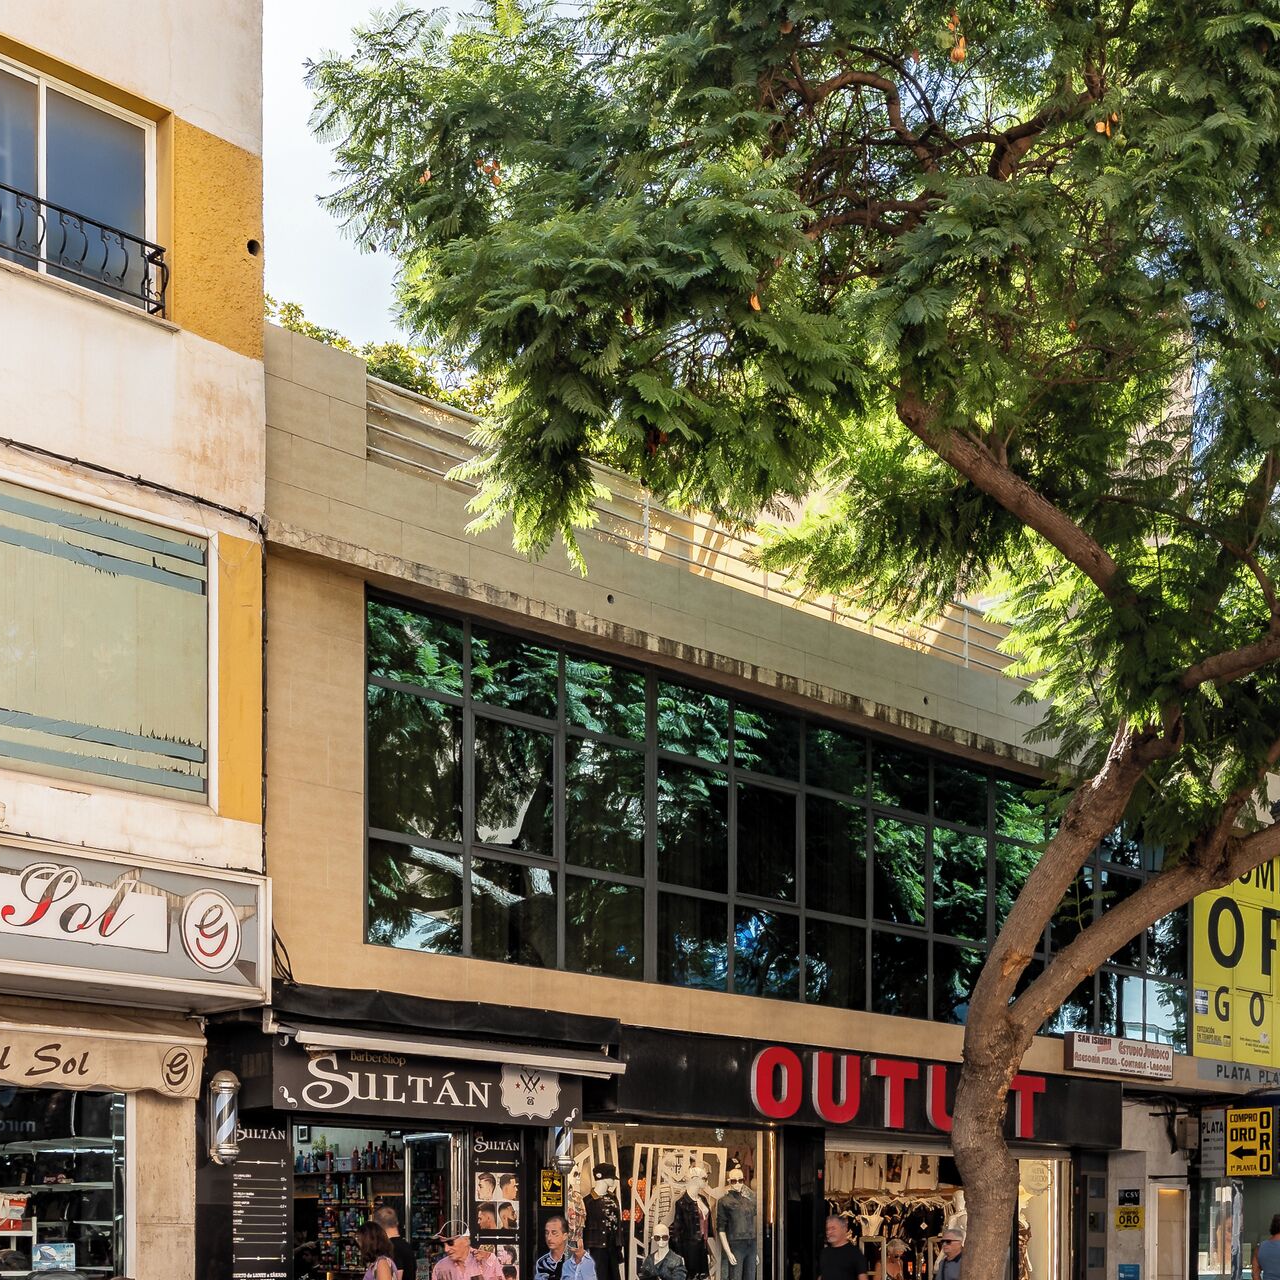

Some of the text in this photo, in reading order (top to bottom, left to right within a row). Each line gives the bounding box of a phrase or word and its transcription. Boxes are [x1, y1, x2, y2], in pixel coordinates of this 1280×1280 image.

[1, 862, 138, 938] Sol
[24, 1043, 90, 1076] Sol
[1216, 1064, 1251, 1082] PLATA
[1230, 1113, 1257, 1123] COMPRO
[1202, 1121, 1224, 1134] PLATA
[1231, 1127, 1256, 1142] ORO
[1119, 1215, 1140, 1225] ORO
